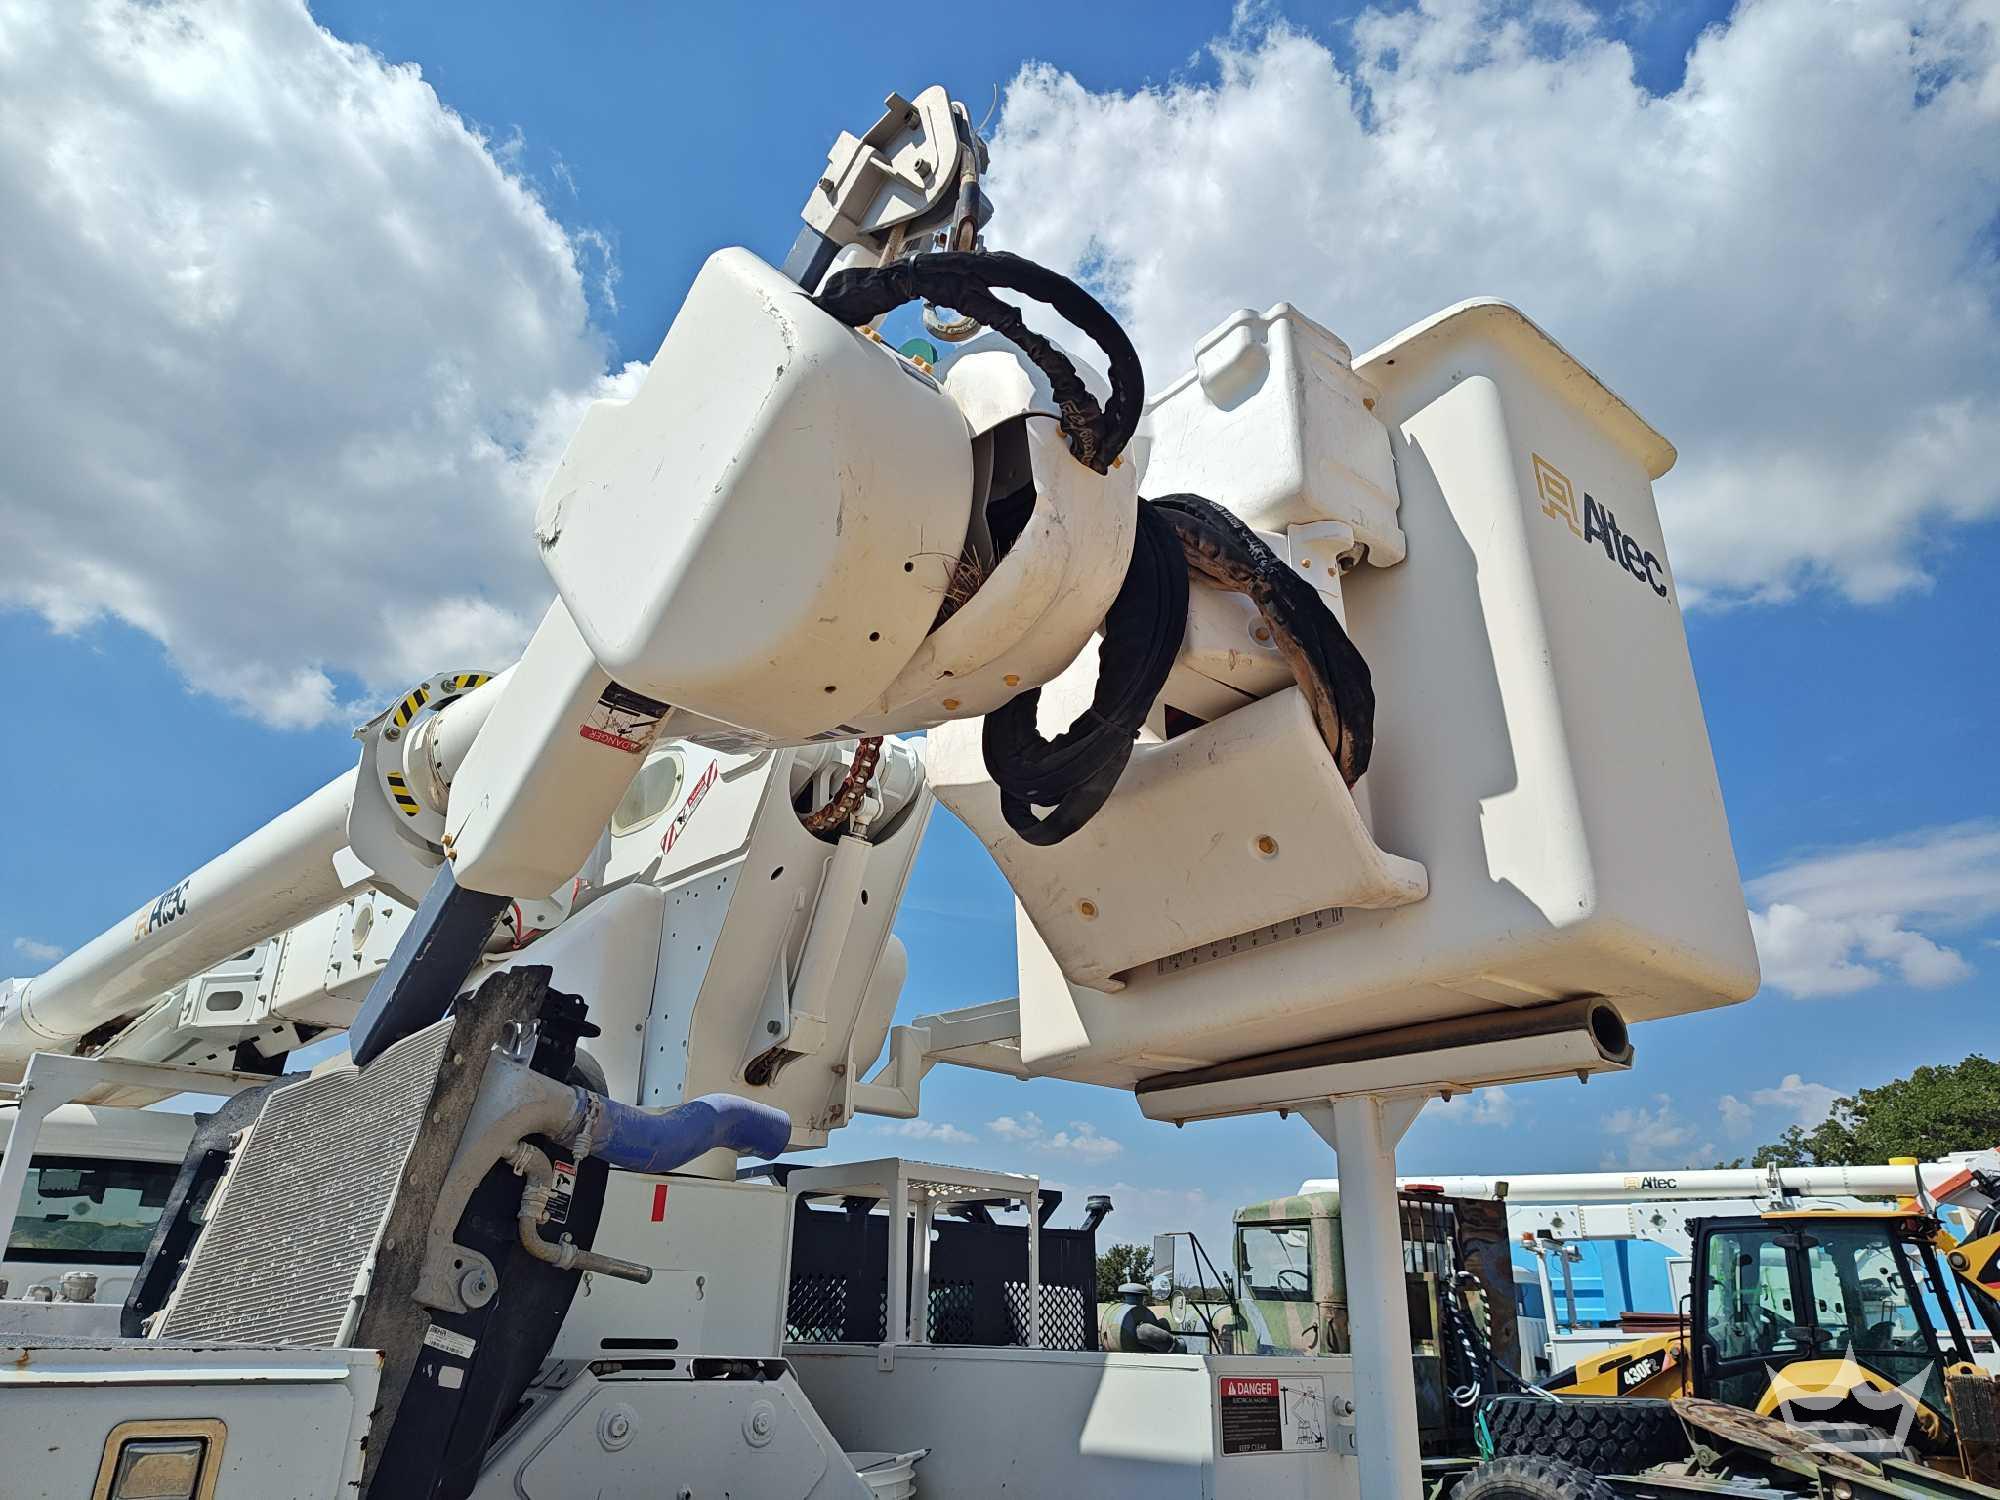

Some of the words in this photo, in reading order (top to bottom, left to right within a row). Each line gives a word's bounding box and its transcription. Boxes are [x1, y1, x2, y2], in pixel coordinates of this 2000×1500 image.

[1583, 491, 1667, 598] Altec
[590, 729, 631, 749] DANGER
[149, 879, 190, 933] Altec
[1641, 1176, 1677, 1189] Altec
[1623, 1358, 1660, 1385] 430F2
[1237, 1382, 1271, 1395] DANGER
